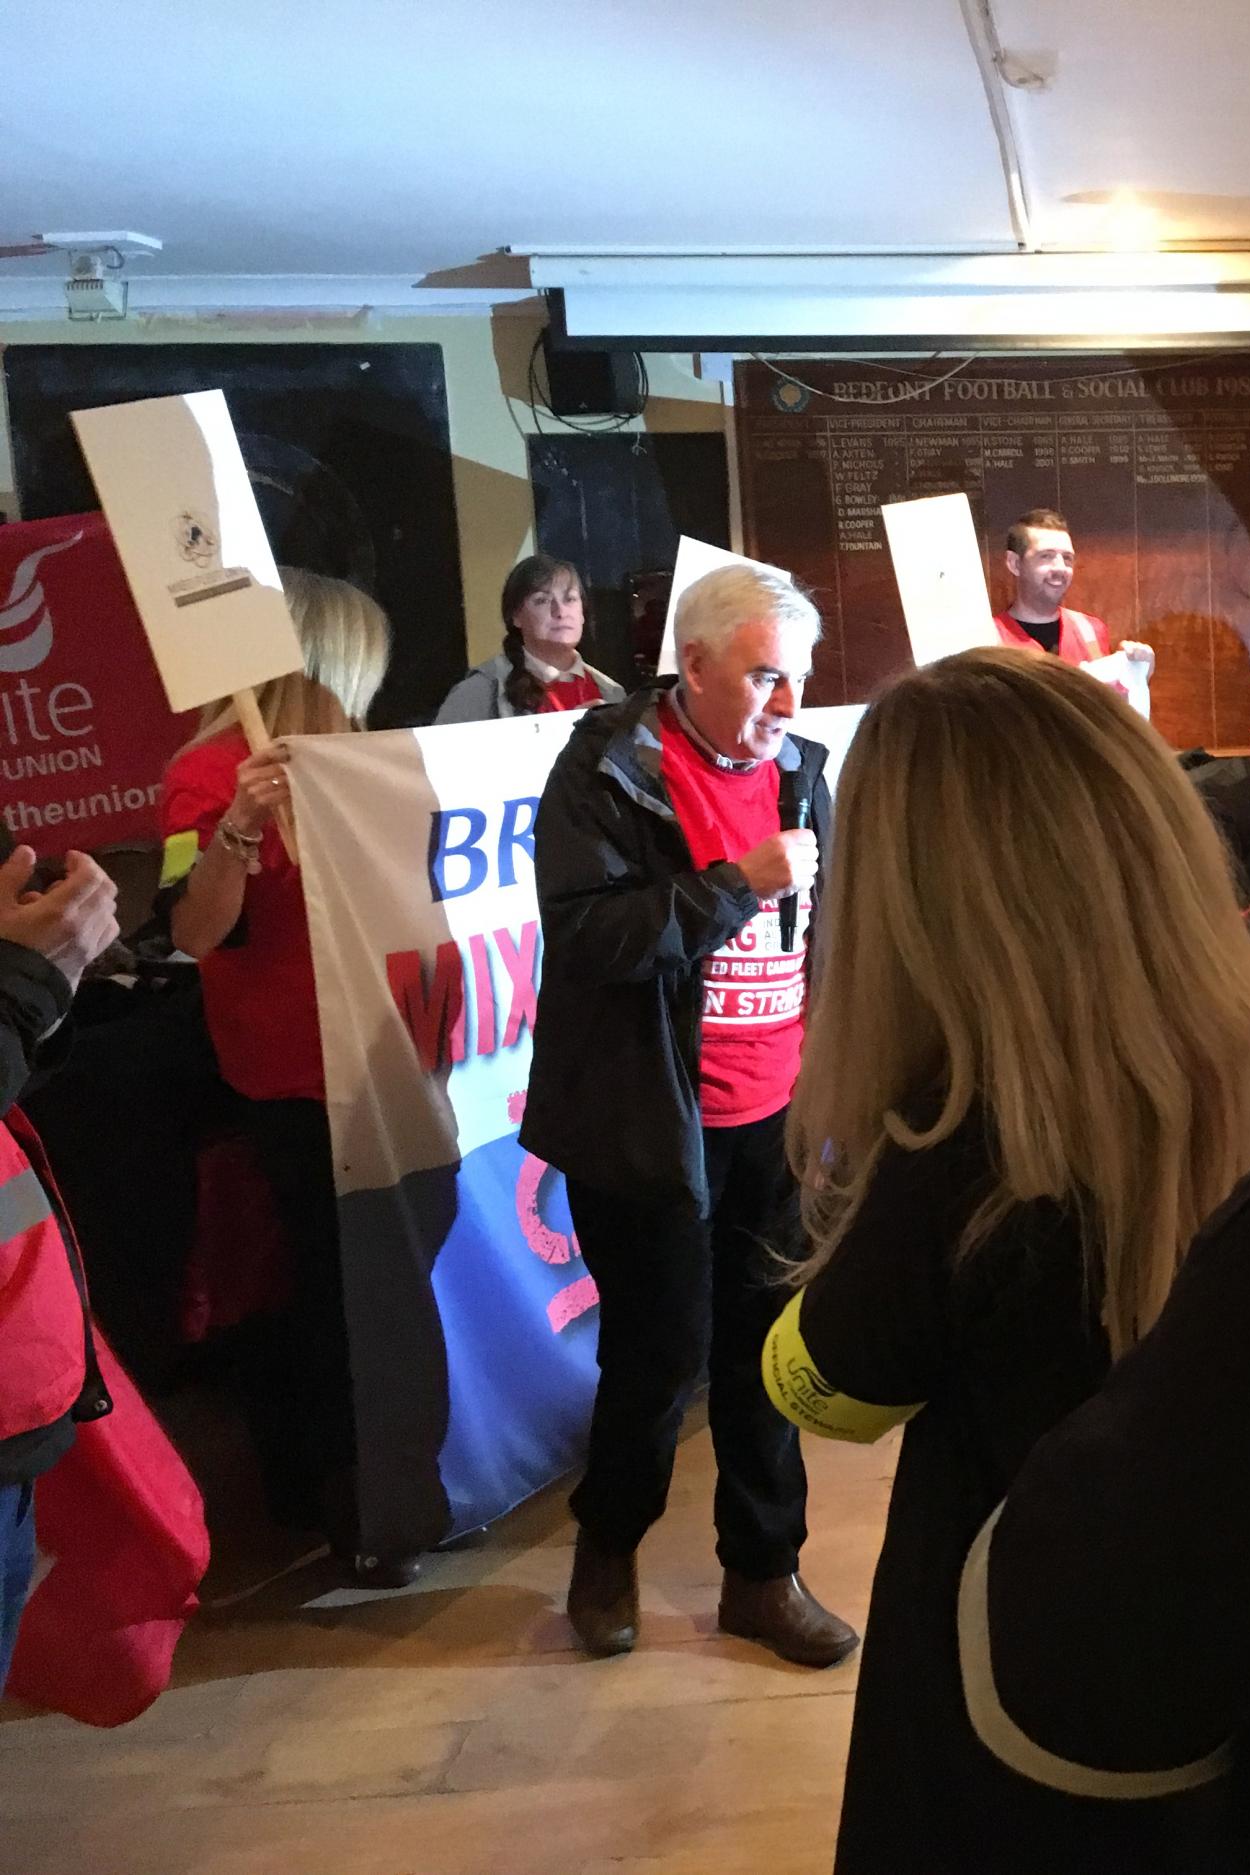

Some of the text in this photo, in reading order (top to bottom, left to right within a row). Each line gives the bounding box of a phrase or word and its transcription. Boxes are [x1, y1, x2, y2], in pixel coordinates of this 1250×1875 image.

[944, 379, 1057, 400] FOOTBALL
[1062, 382, 1075, 398] &
[1078, 377, 1150, 399] SOCIAL
[1157, 376, 1209, 397] CLUB
[912, 418, 968, 429] CHAIRMAN
[2, 744, 102, 781] UNION
[731, 961, 764, 977] FLEET
